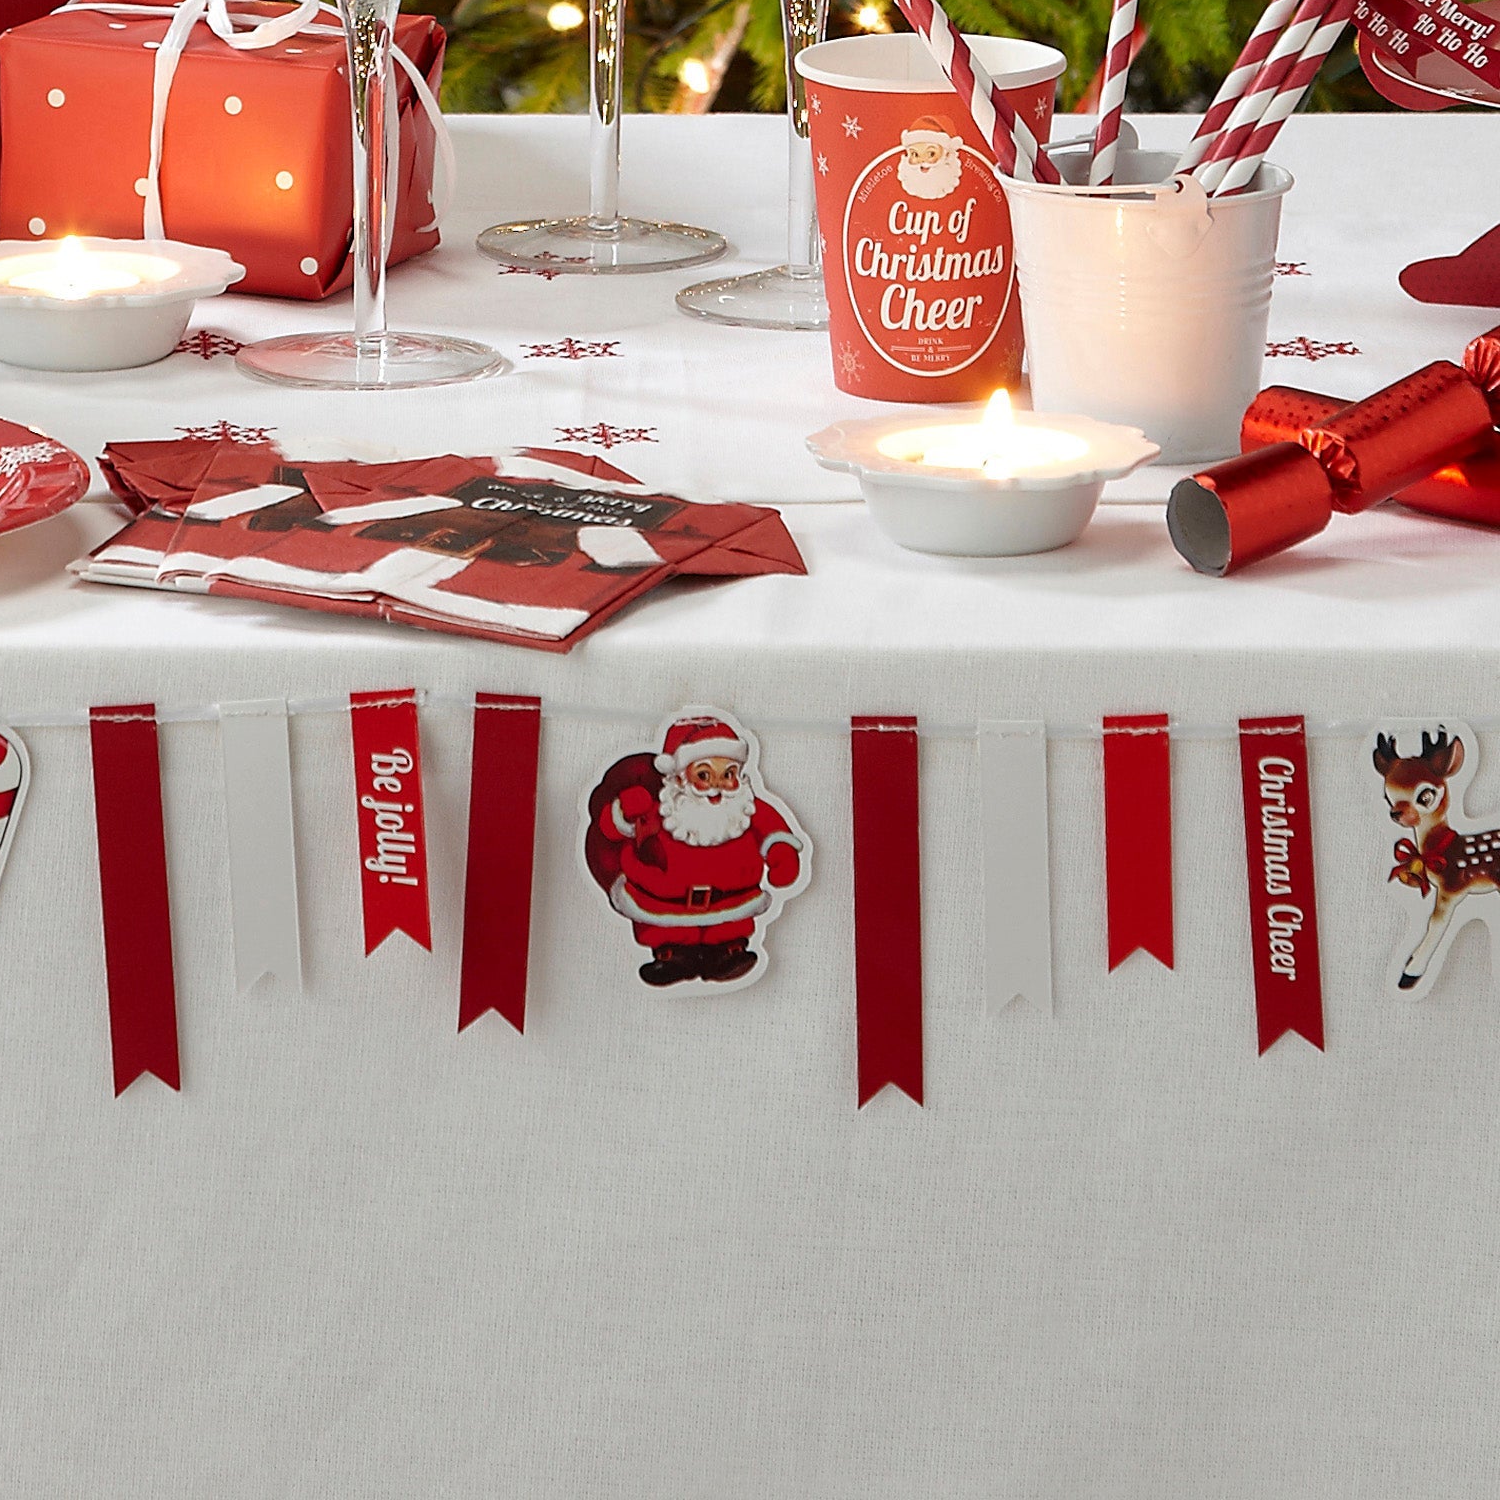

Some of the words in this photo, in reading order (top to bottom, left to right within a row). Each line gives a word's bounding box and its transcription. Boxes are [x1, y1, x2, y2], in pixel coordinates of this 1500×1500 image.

[1367, 11, 1388, 37] Ho
[1388, 28, 1410, 54] Ho
[1413, 13, 1437, 36] Ho
[1436, 26, 1462, 51] Ho
[1462, 42, 1488, 68] Ho
[888, 201, 943, 246] Cup
[947, 197, 977, 244] of
[854, 237, 1004, 282] Christmas
[880, 283, 983, 331] Cheer
[917, 337, 944, 345] DRINK
[370, 747, 414, 793] Be
[360, 795, 418, 886] jolly!
[1257, 755, 1296, 896] Christmas
[1266, 903, 1304, 982] Cheer
